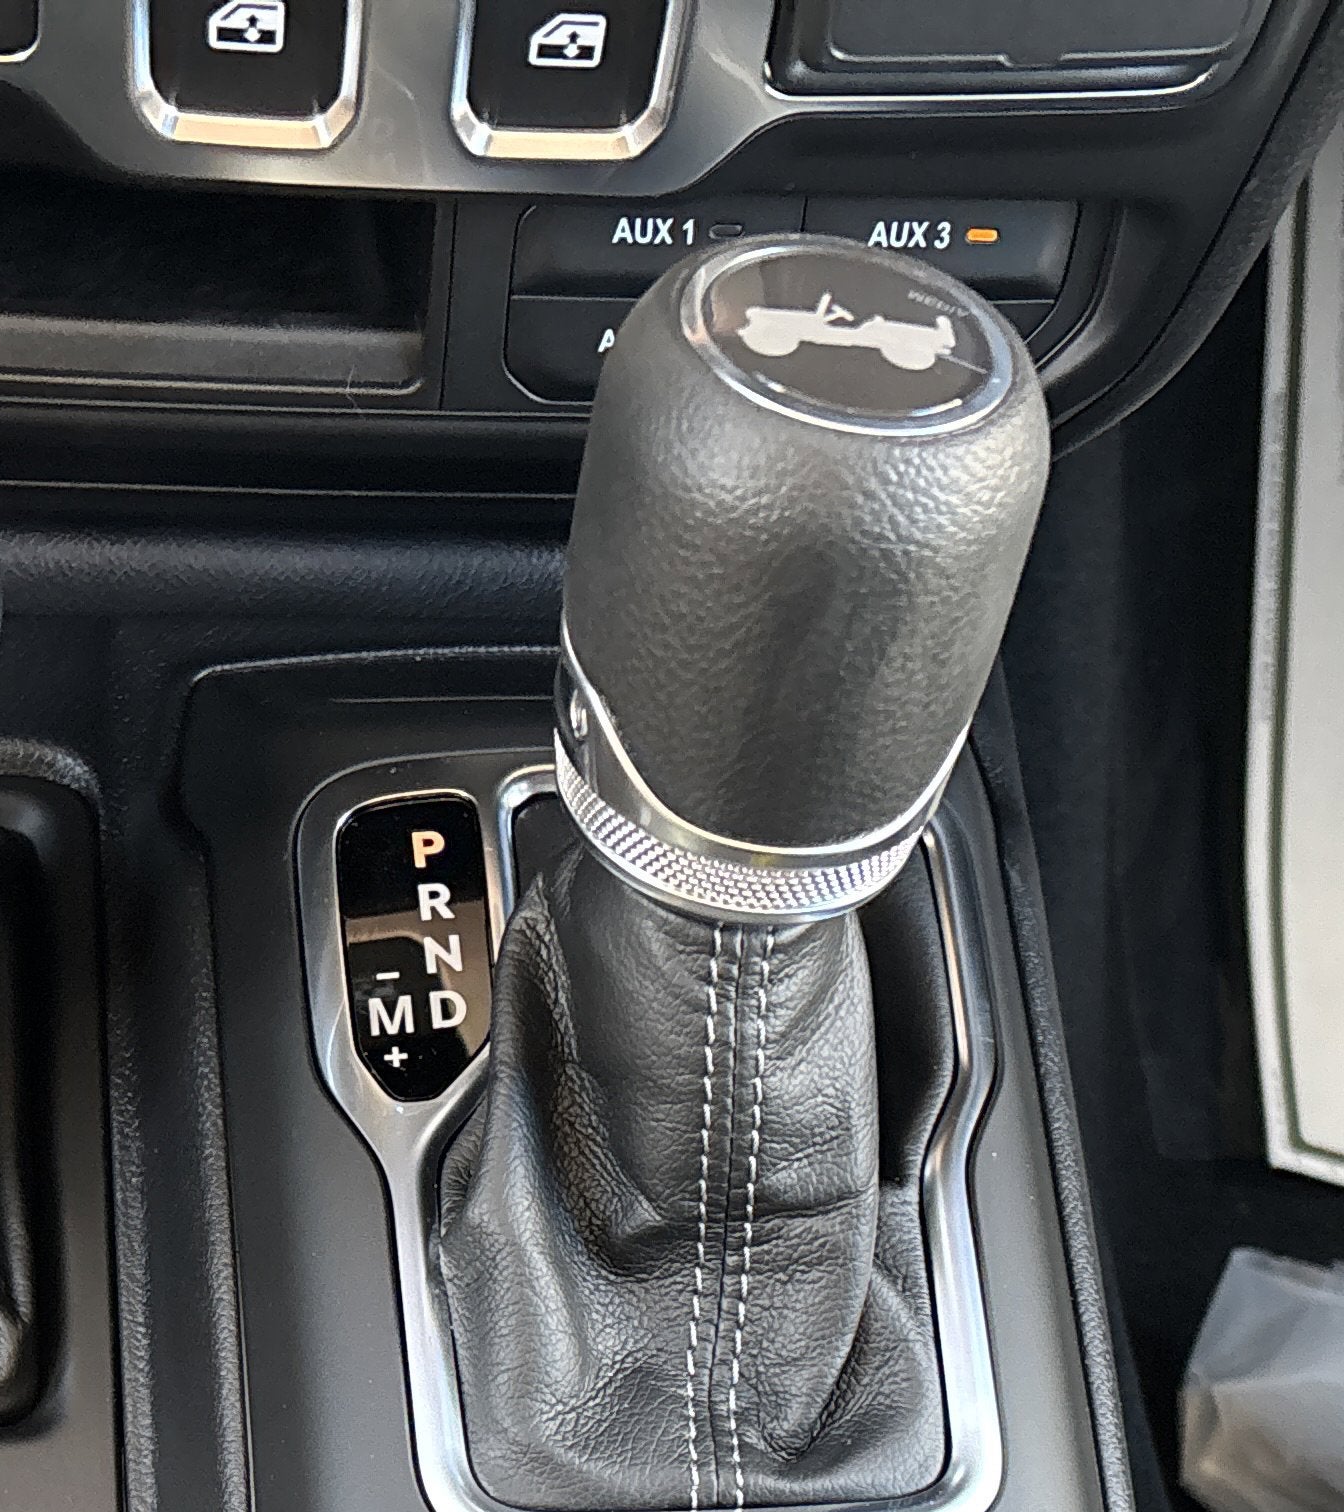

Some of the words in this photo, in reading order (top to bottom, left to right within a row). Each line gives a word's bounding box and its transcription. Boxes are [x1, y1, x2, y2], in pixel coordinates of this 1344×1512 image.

[611, 218, 676, 245] AUX
[680, 218, 696, 245] 1
[867, 221, 929, 248] AUX
[934, 221, 951, 249] 3
[411, 831, 445, 869] P
[418, 883, 455, 922] R
[424, 935, 464, 976] N
[368, 995, 415, 1037] M
[430, 990, 467, 1029] D
